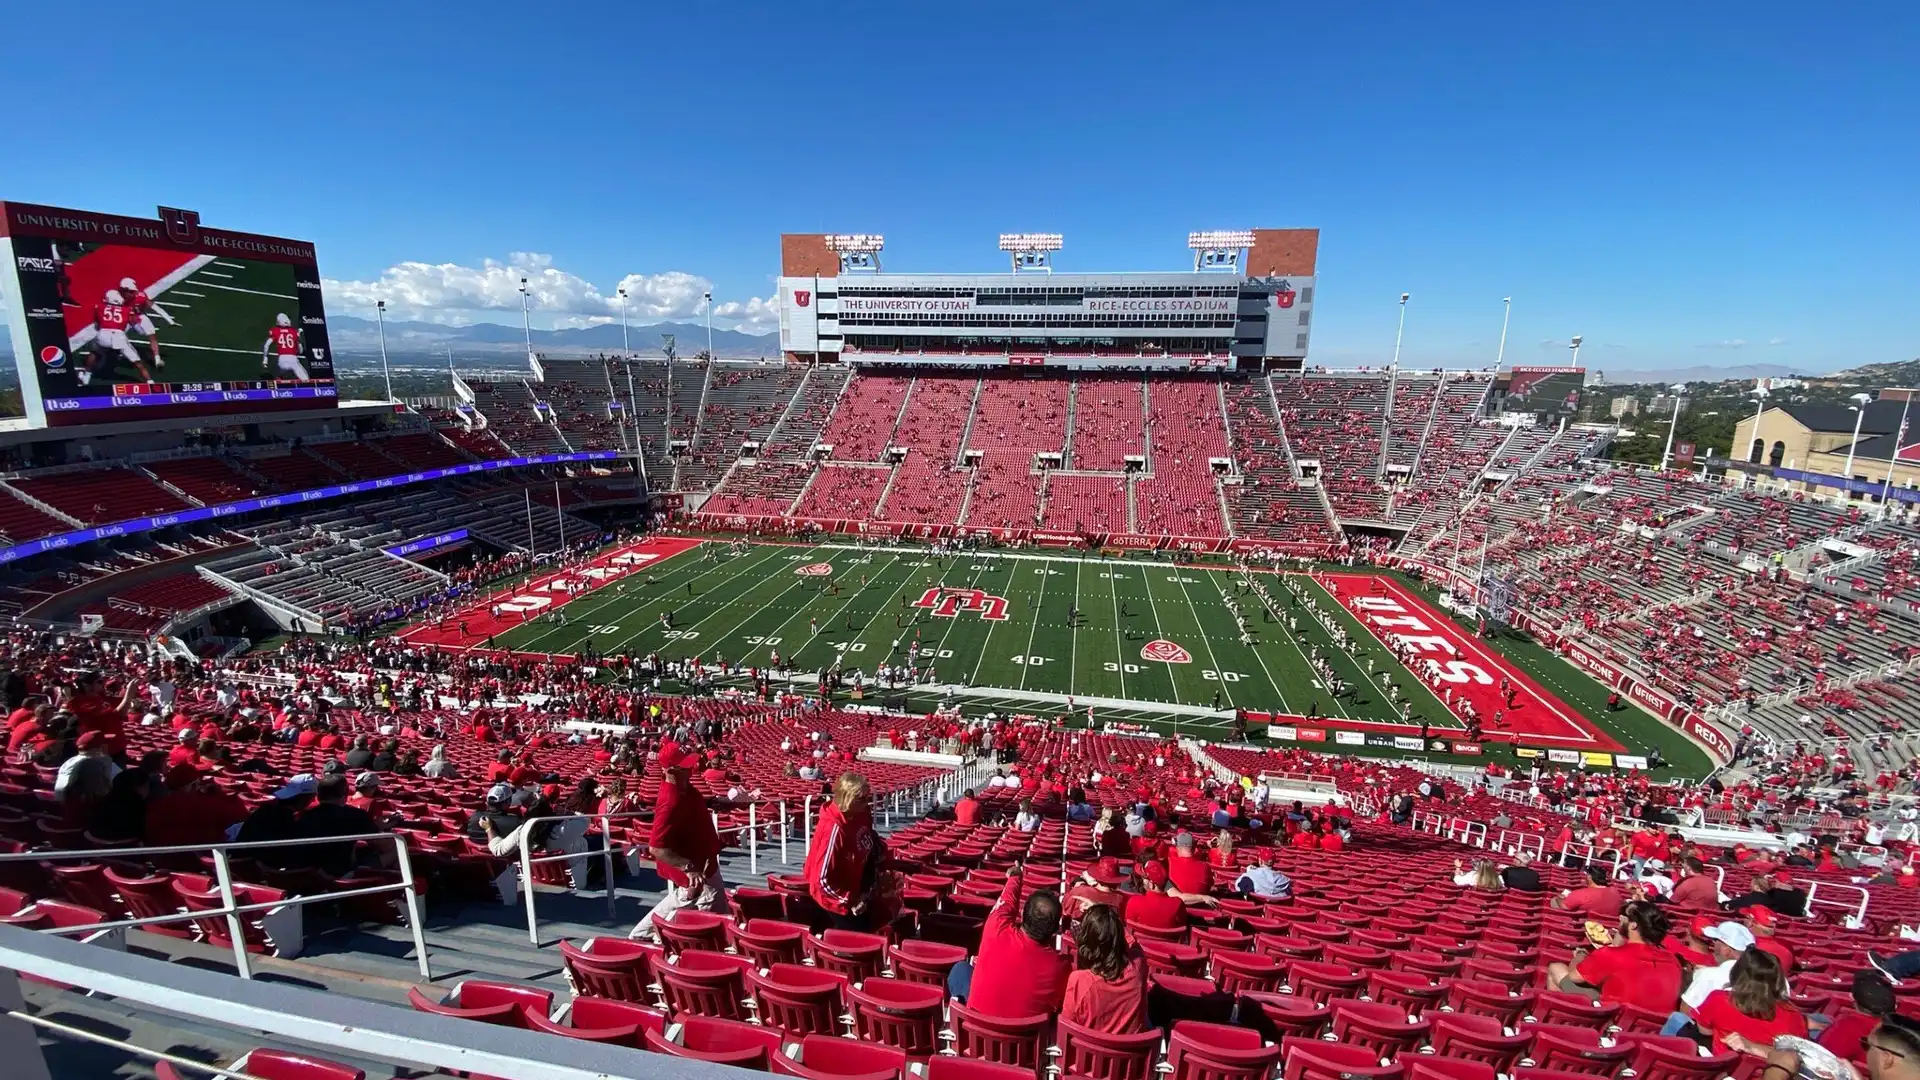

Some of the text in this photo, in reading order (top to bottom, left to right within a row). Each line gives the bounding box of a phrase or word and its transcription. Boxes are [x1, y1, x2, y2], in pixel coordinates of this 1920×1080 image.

[17, 213, 159, 239] UNIVERSITY OF UTAH
[203, 235, 313, 258] RICE-ECCLES STADIUM
[844, 300, 970, 310] THE UNIVERSITY OF UTAH
[1089, 300, 1229, 310] RICE-ECCLES STADIUM
[103, 307, 123, 324] 55
[278, 333, 294, 349] 46
[1426, 566, 1447, 580] ZONE
[664, 630, 700, 640] 20
[747, 636, 783, 646] 30
[833, 642, 867, 652] 40
[919, 648, 954, 658] 50
[1010, 655, 1044, 666] 40
[1571, 650, 1614, 680] RED ZONE
[1103, 662, 1139, 673] 30
[1202, 670, 1240, 682] 20
[1634, 685, 1666, 711] UFIRST
[1695, 723, 1717, 745] RED
[1368, 739, 1394, 747] URBAN
